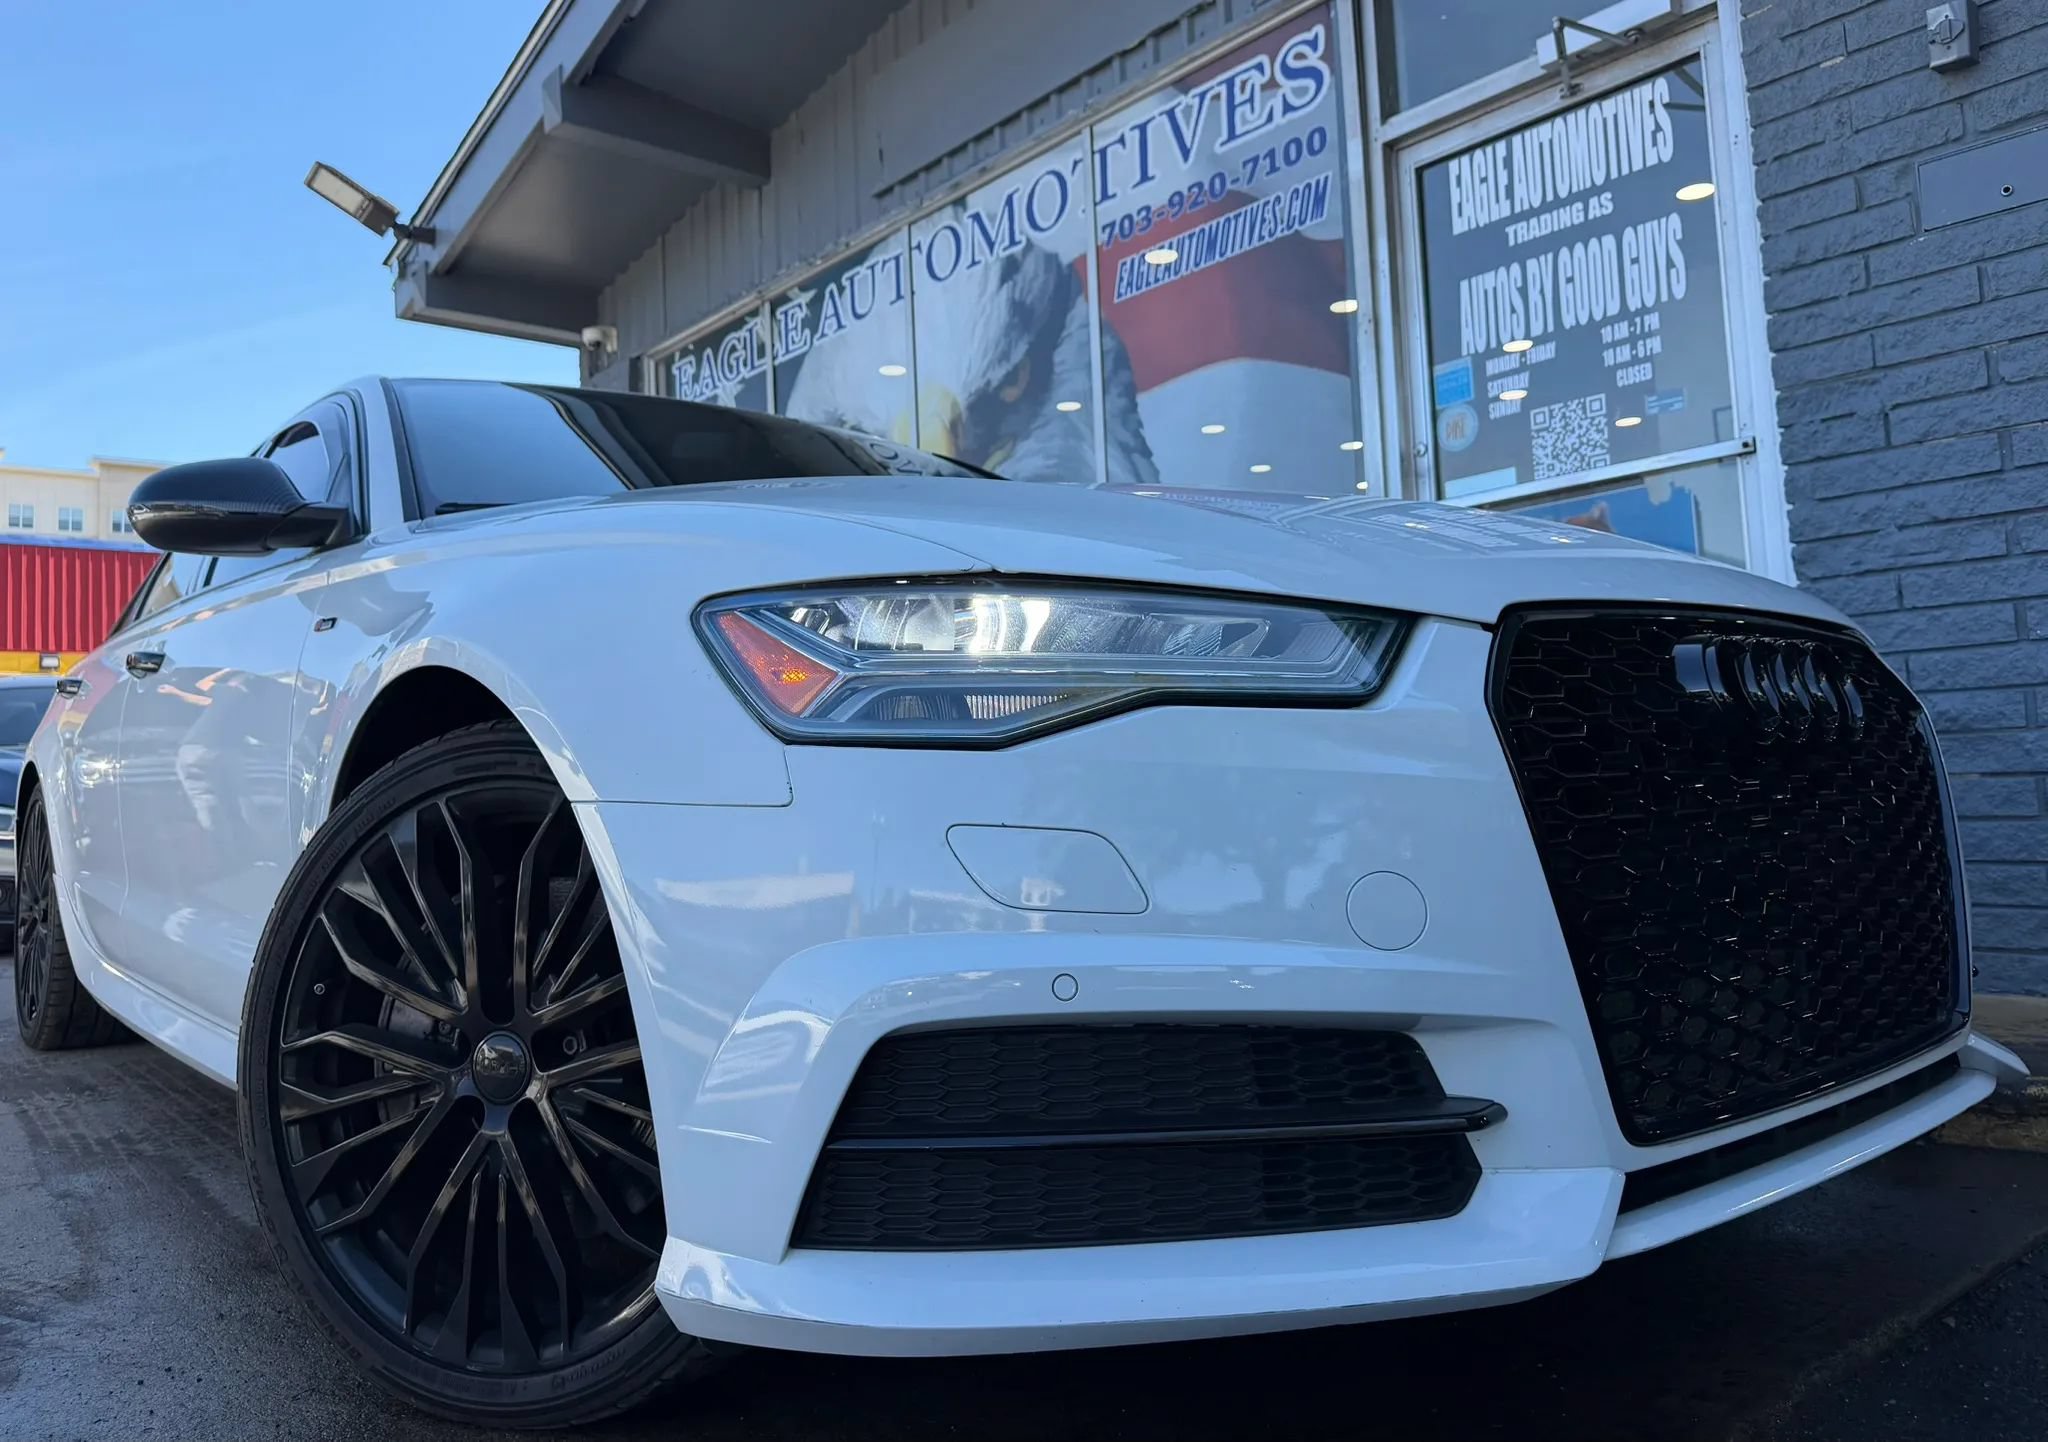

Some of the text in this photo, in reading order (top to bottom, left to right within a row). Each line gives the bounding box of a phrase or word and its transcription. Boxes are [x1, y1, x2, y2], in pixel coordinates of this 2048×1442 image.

[1448, 77, 1674, 236] EAGLE AUTOMOTIVES
[1102, 126, 1328, 248] 703-920-7100
[673, 26, 1331, 400] EAGLE AUTOMOTIVES
[1505, 191, 1613, 246] TRADING AS
[1115, 174, 1331, 301] EAGLEAUTOMOTIVES.COM
[1459, 212, 1687, 356] AUTOS BY GOOD GUYS
[1600, 325, 1612, 344] 10
[1614, 320, 1629, 341] AM
[1634, 316, 1641, 335] 7
[1644, 312, 1660, 332] PM
[1486, 352, 1520, 377] MONDAY
[1526, 341, 1556, 365] FRIDAY
[1602, 348, 1614, 367] 10
[1615, 343, 1631, 364] AM
[1637, 340, 1645, 358] 6
[1646, 335, 1662, 356] PM
[1487, 371, 1530, 398] SATURDAY
[1616, 362, 1653, 388] CLOSED
[1488, 397, 1521, 420] SUNDAY
